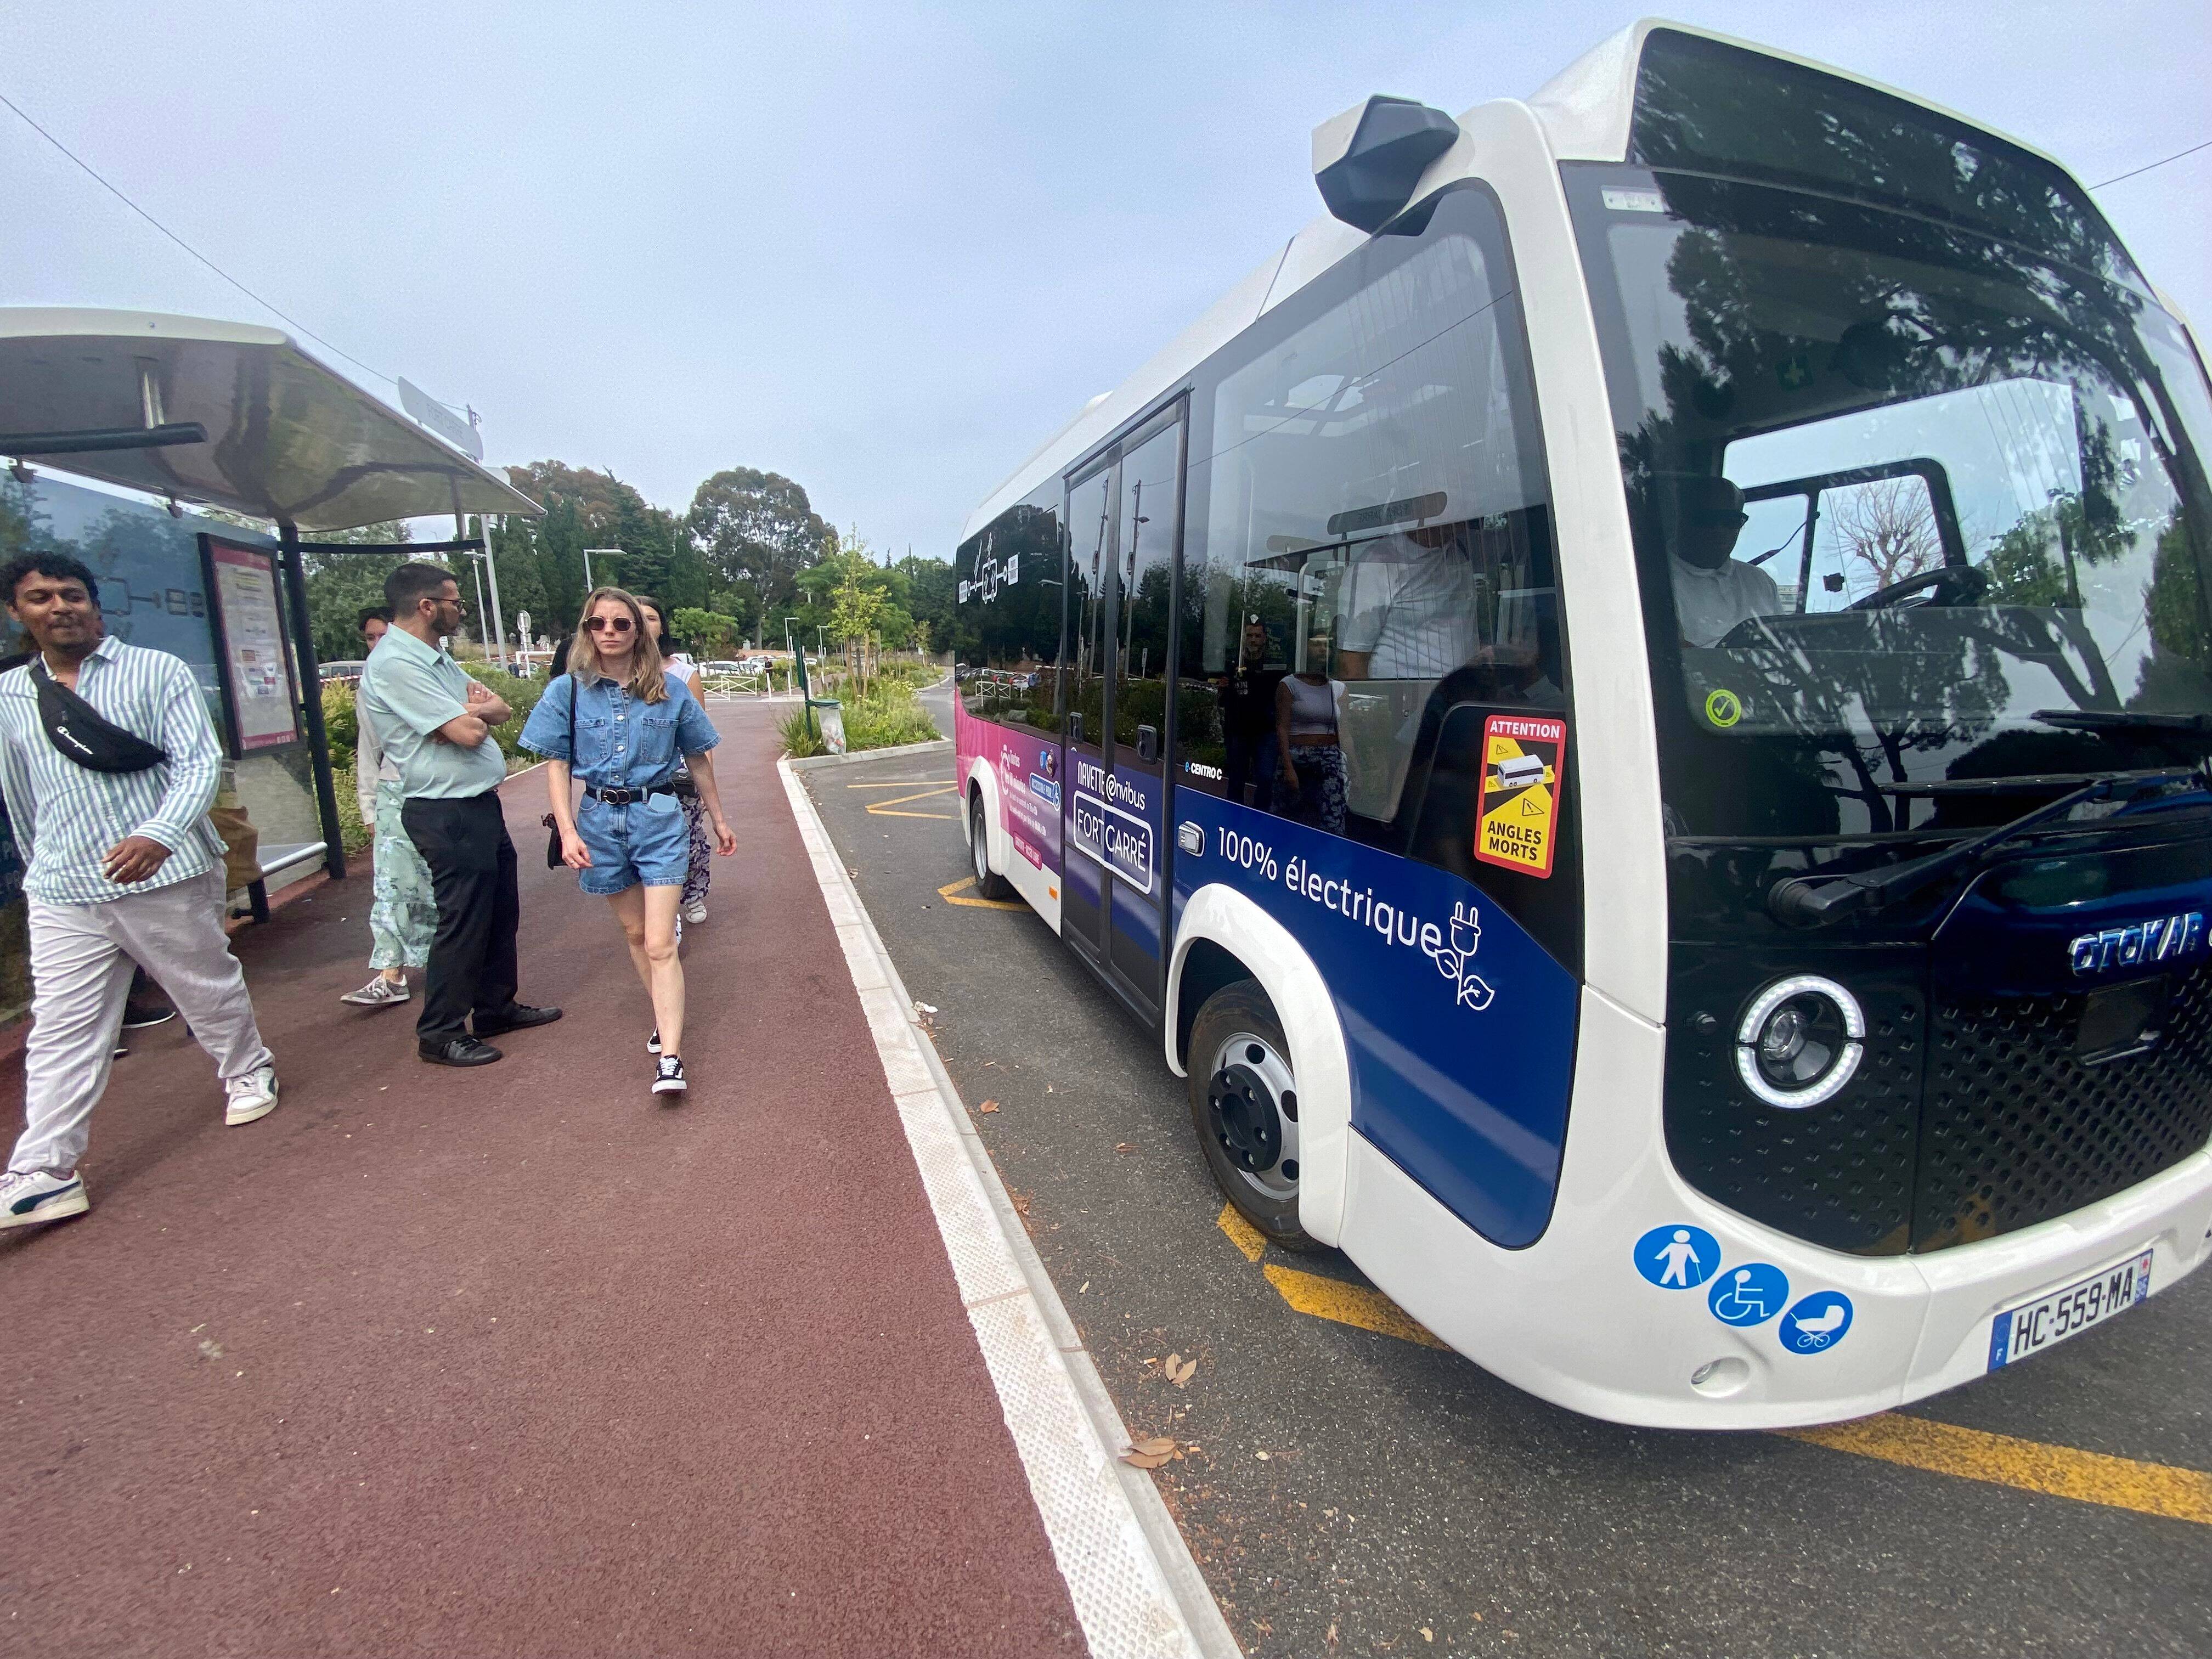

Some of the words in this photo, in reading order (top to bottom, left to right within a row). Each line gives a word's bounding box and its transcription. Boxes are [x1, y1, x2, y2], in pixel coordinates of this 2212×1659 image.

[1489, 720, 1560, 738] ATTENTION
[1077, 760, 1105, 796] NAVETTE
[1216, 768, 1222, 781] C
[1077, 808, 1104, 845] FORT
[1105, 825, 1146, 872] CARRÉ
[1487, 821, 1542, 845] ANGLES
[1488, 836, 1538, 861] MORTS
[1218, 826, 1278, 881] 100%
[1285, 855, 1442, 958] électrique
[2067, 911, 2203, 977] OTOKAR
[1996, 1347, 2004, 1361] F
